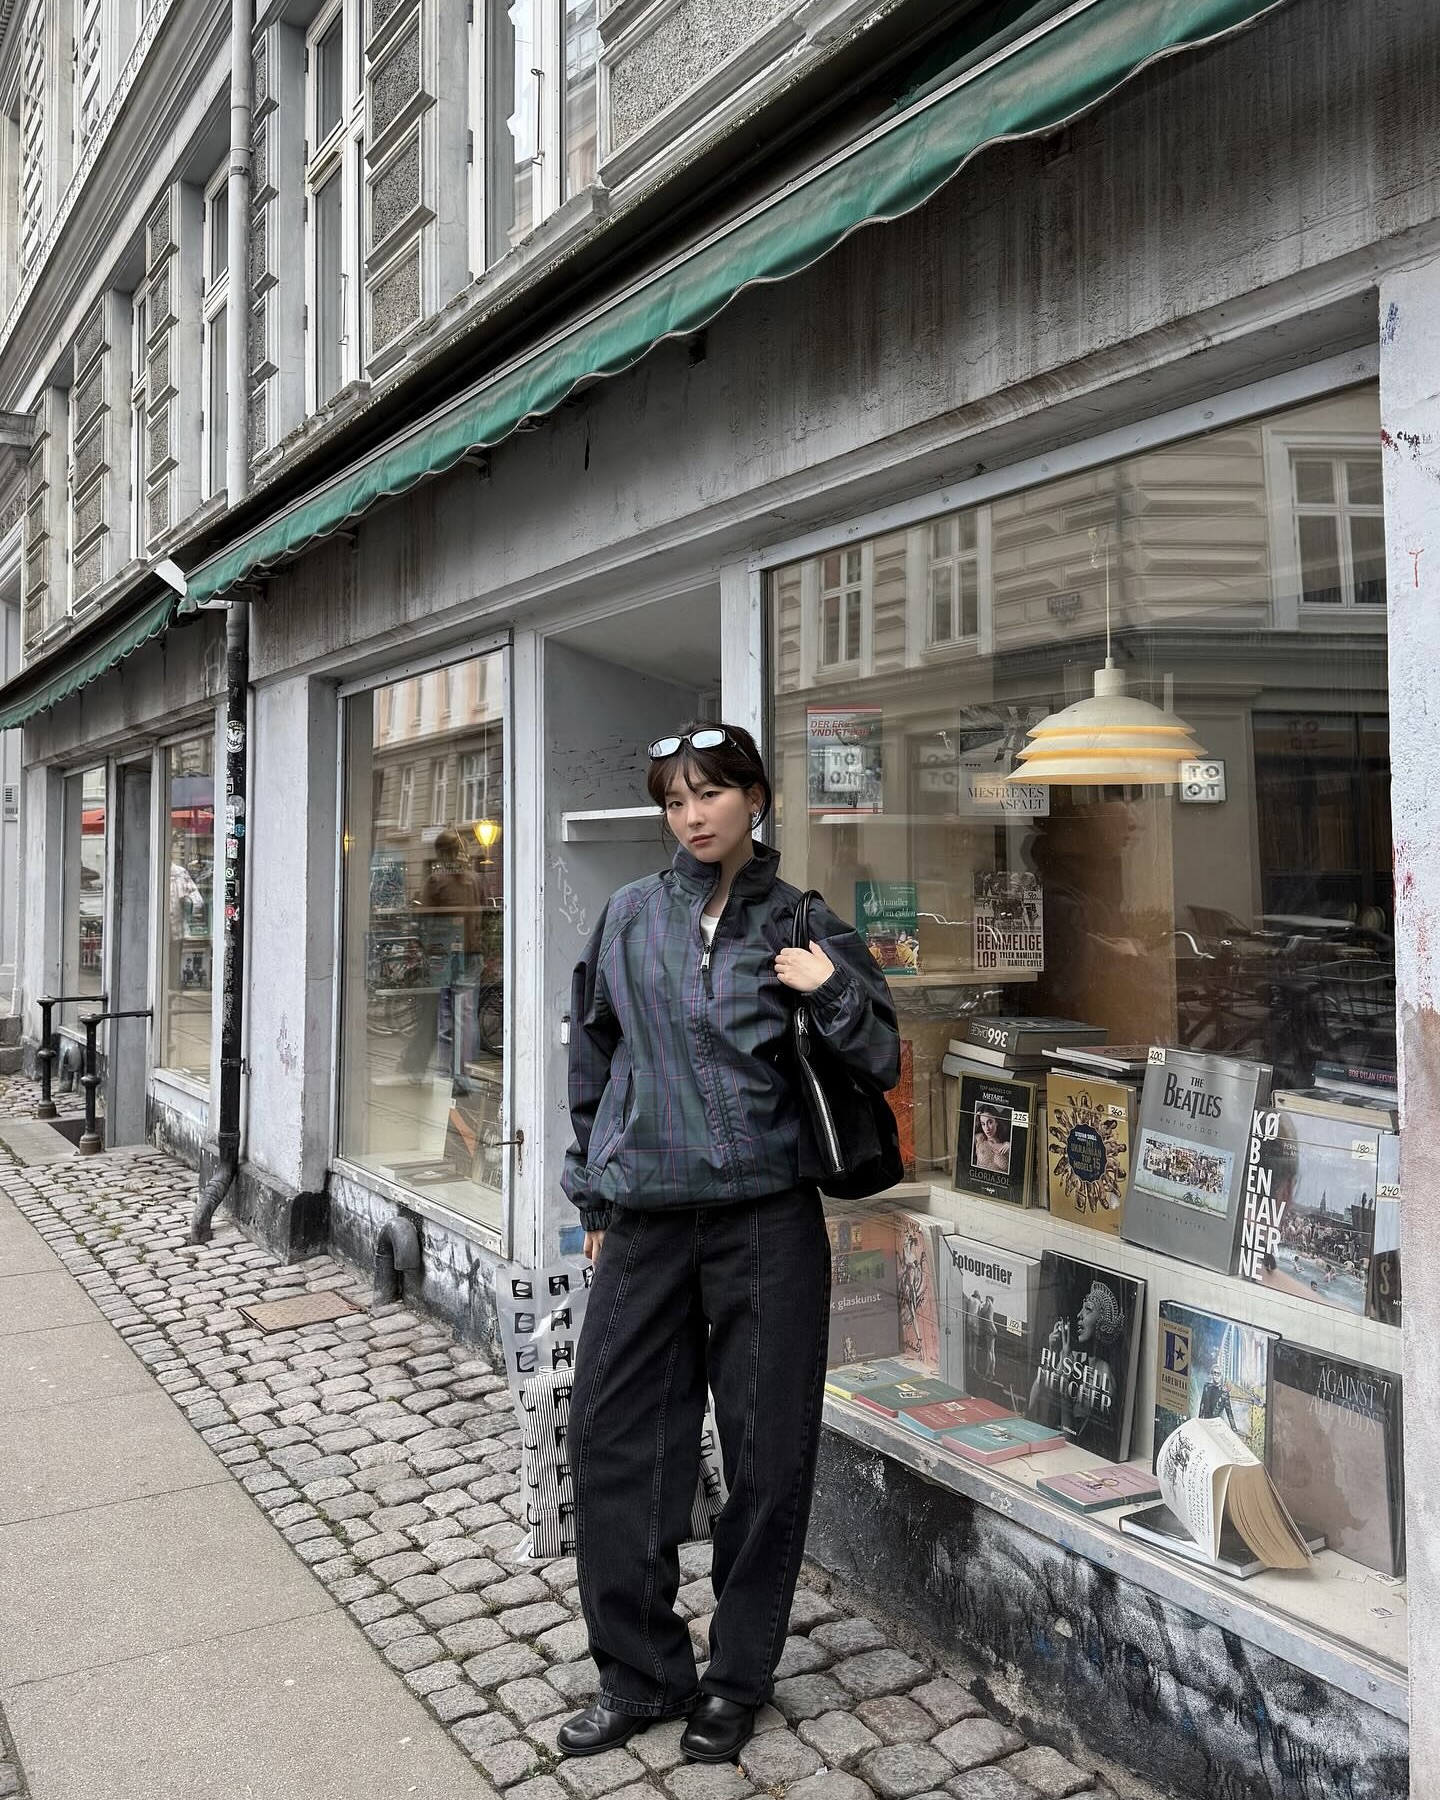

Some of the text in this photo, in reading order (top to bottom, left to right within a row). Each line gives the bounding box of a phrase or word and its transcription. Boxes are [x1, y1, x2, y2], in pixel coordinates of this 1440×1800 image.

[968, 786, 1045, 799] MESTRENES
[1000, 798, 1044, 810] ASFALT
[977, 934, 1042, 951] HEMMELIGE
[987, 1027, 1009, 1048] 366
[1149, 1050, 1163, 1060] 200
[1163, 1072, 1222, 1120] BEATLES
[1191, 1077, 1205, 1088] THE
[1160, 1116, 1219, 1135] ANTHOLOGY
[1252, 1110, 1281, 1142] KØ
[1249, 1137, 1261, 1164] B
[968, 1169, 995, 1182] GLORIA
[1246, 1164, 1273, 1196] EN
[1381, 1186, 1399, 1196] 240
[1244, 1191, 1287, 1227] HAV
[1241, 1219, 1281, 1258] NER
[952, 1250, 1012, 1285] Fotografier
[1238, 1246, 1265, 1281] NE
[837, 1293, 881, 1311] glaskunst
[1041, 1347, 1110, 1394] RUSSELL
[1038, 1366, 1112, 1415] MELCHER
[1318, 1366, 1377, 1409] AGAINST
